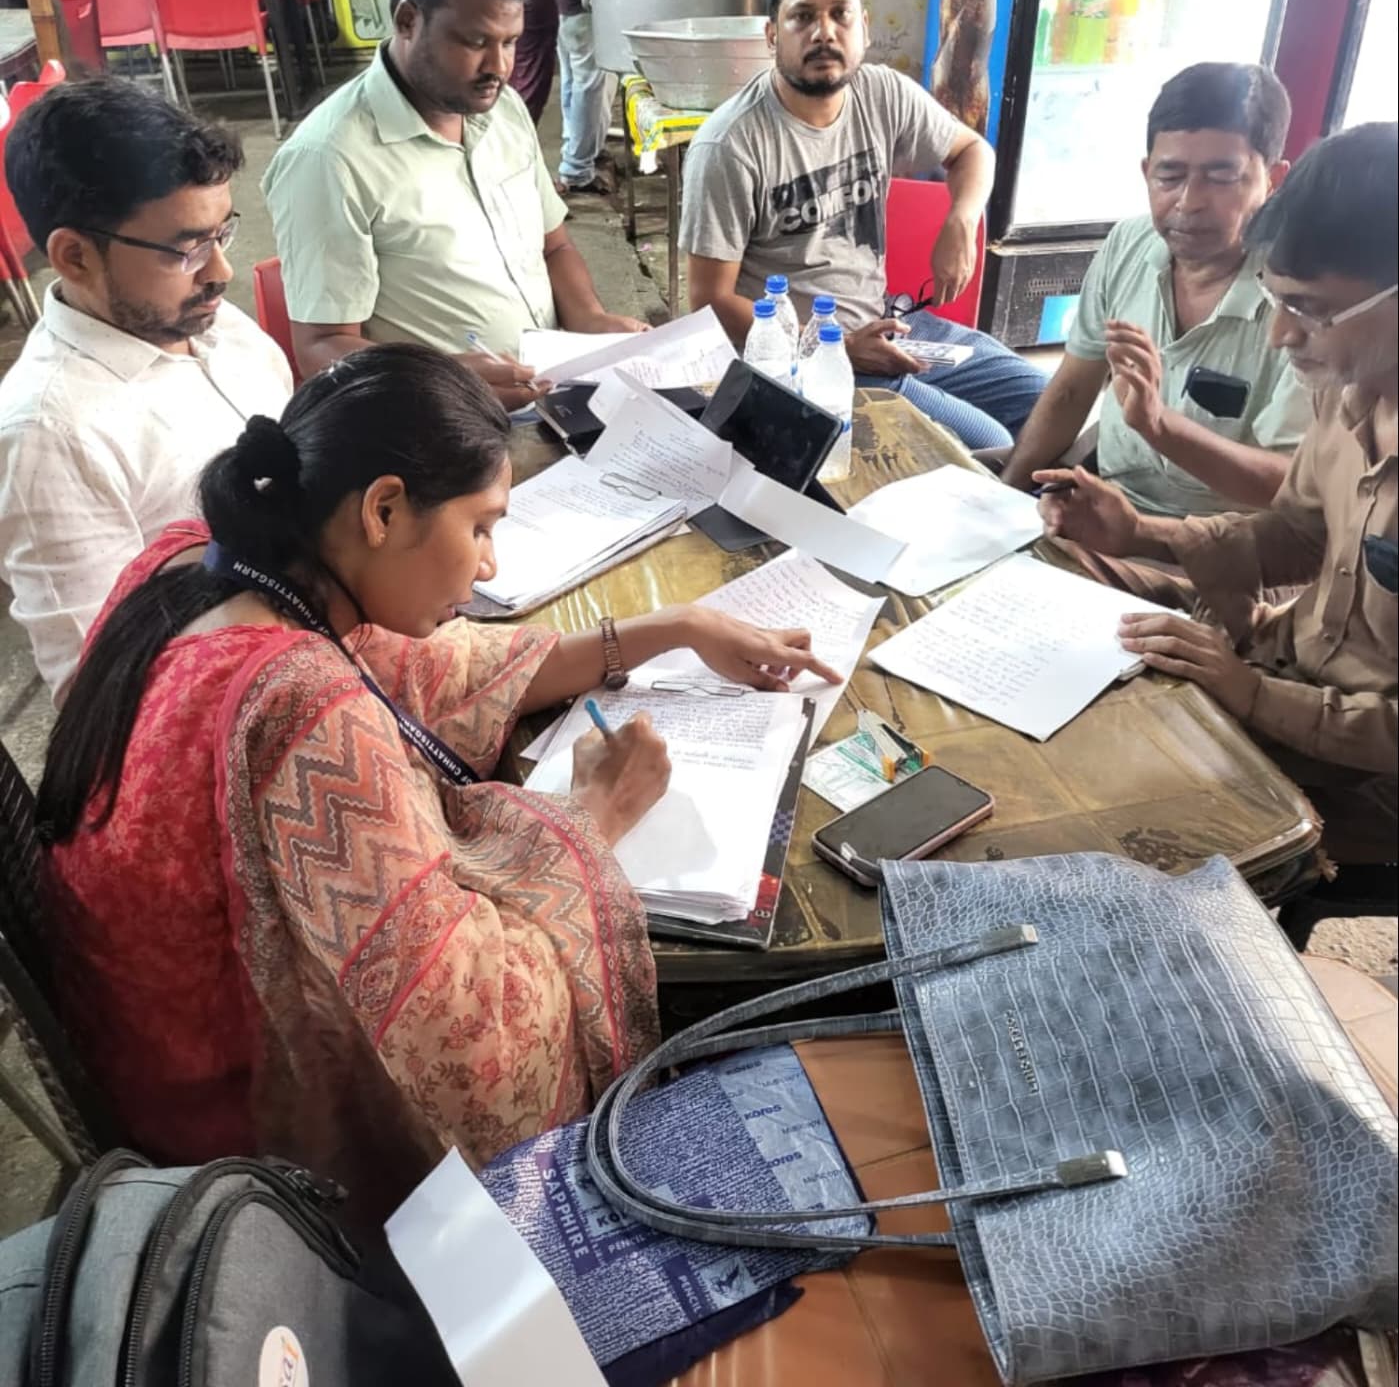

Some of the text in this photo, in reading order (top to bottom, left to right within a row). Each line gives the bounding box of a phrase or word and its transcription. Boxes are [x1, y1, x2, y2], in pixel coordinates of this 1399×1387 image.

[780, 179, 878, 232] COMFO
[232, 559, 318, 626] CHHATTISGARH
[542, 1168, 589, 1258] SAPPHIRE
[608, 1236, 645, 1254] PENCIL
[678, 1275, 702, 1314] PENCIL
